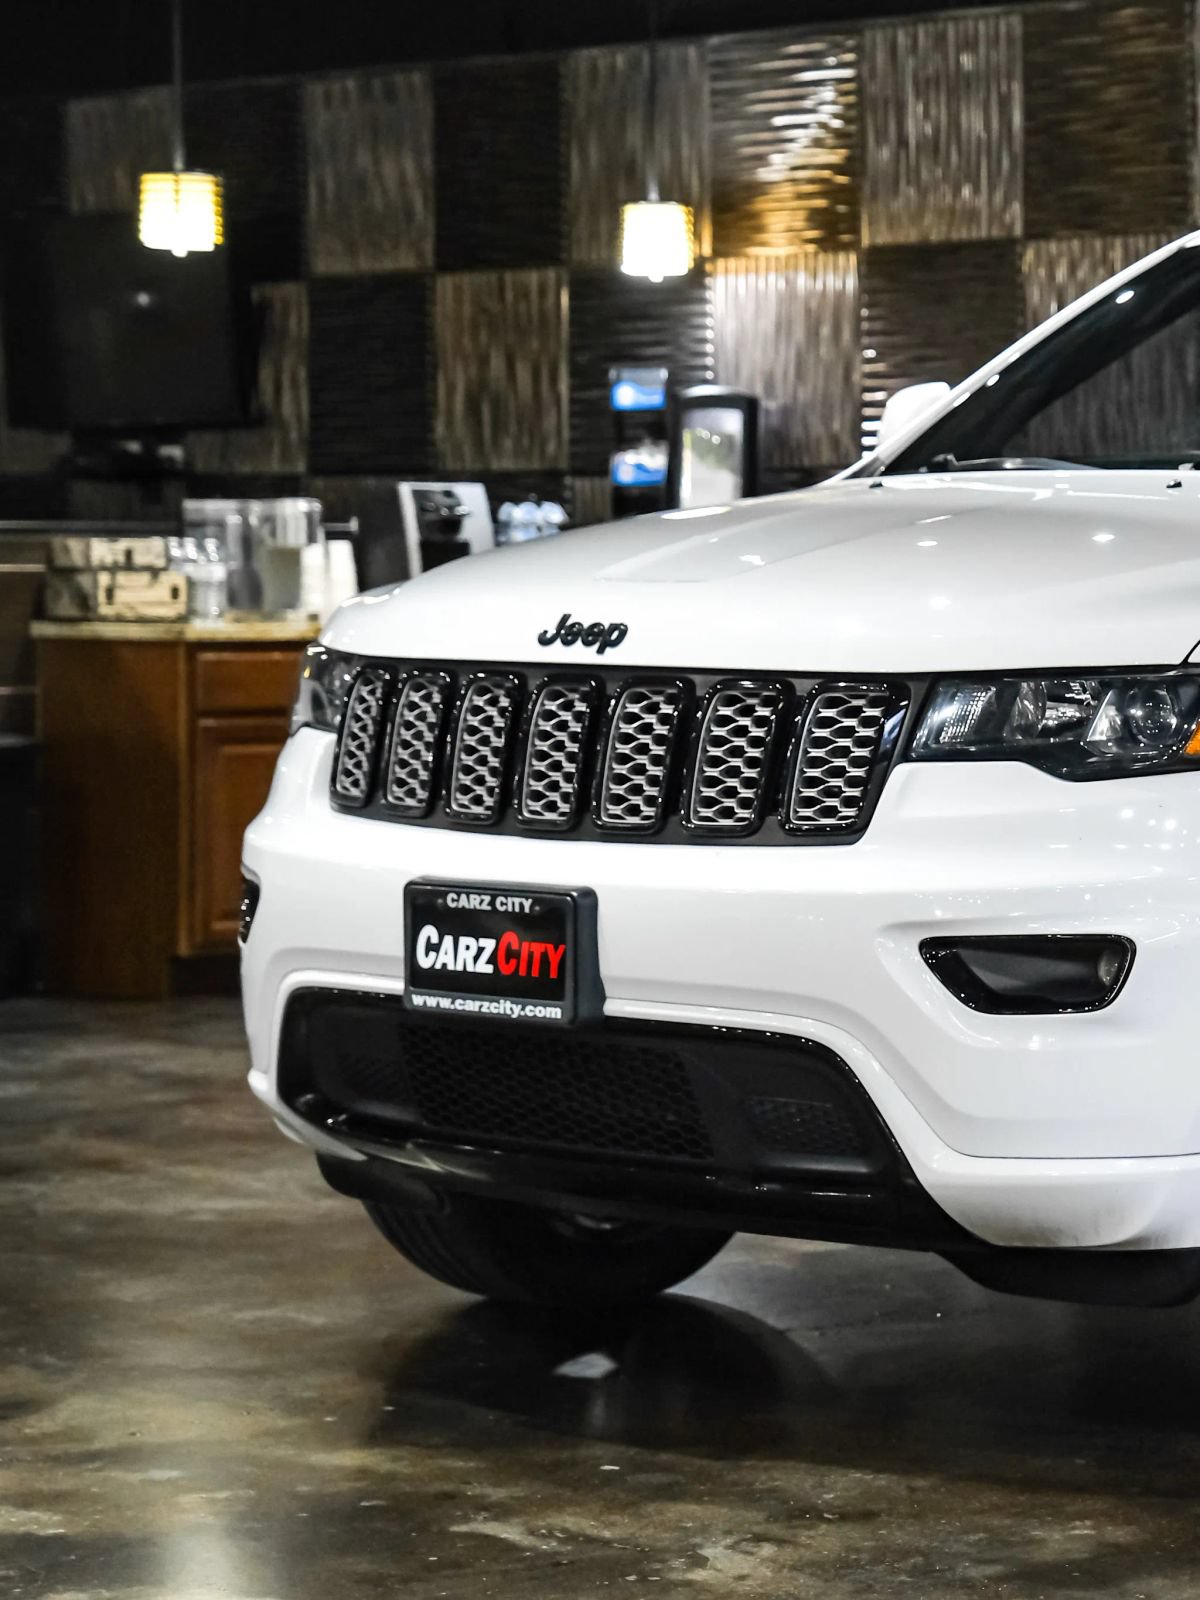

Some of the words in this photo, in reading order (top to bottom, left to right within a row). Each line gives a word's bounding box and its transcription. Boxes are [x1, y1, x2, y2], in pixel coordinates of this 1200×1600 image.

[538, 613, 628, 655] Jeep
[446, 892, 491, 910] CARZ
[495, 896, 532, 913] CITY
[411, 993, 562, 1019] www.carzcity.com
